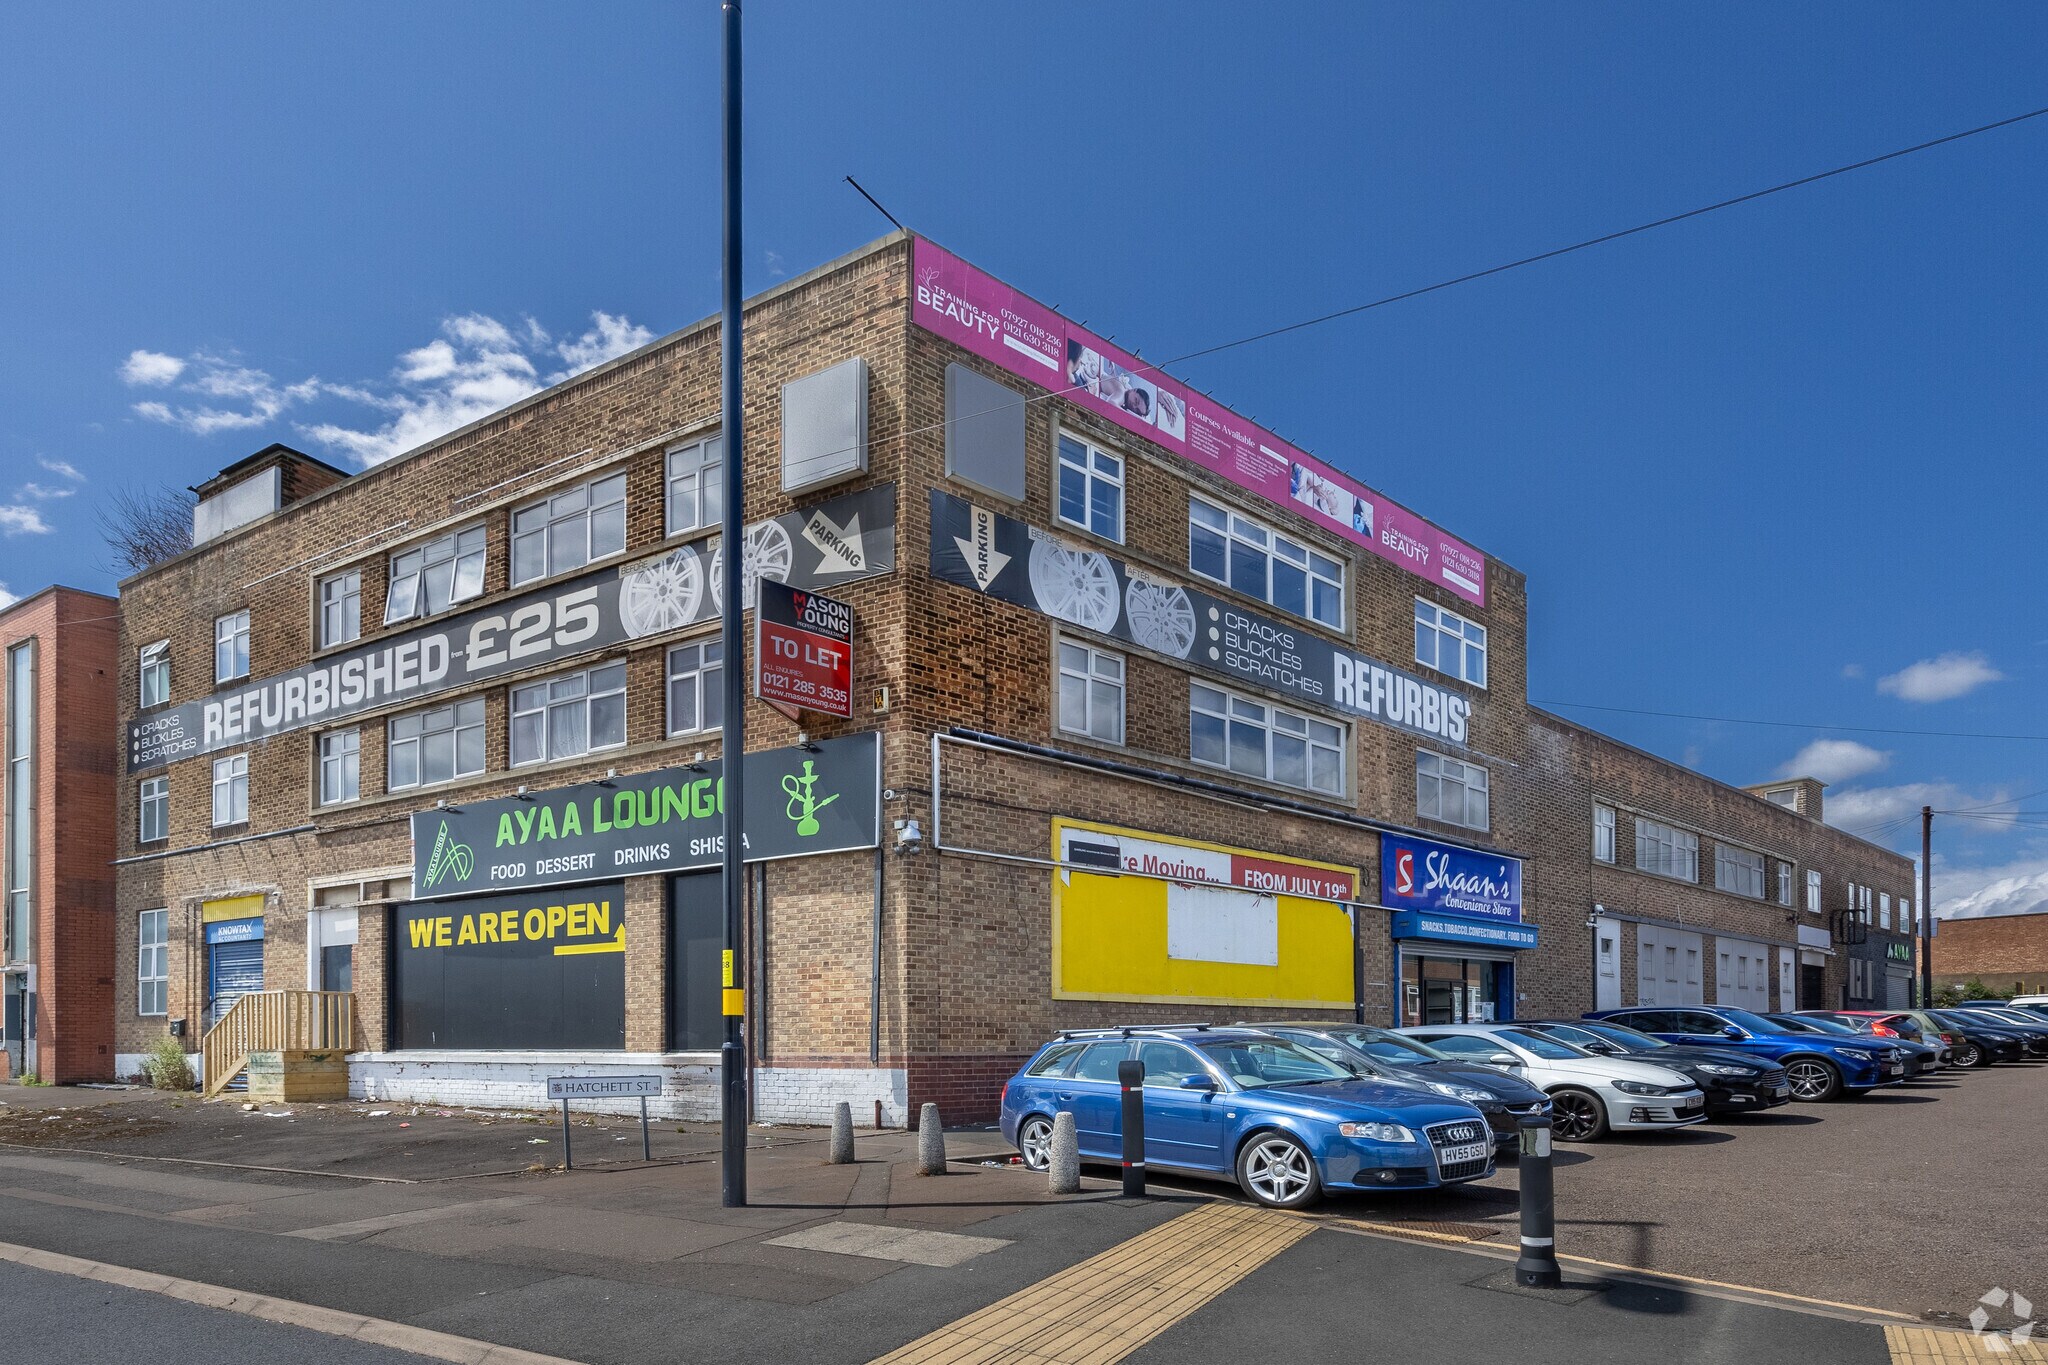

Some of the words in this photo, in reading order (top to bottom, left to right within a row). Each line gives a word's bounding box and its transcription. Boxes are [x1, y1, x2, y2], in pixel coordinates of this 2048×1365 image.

[917, 285, 1000, 340] BEAUTY
[934, 285, 979, 315] TRAINING
[981, 309, 1000, 326] FOR
[1000, 308, 1028, 329] 07927
[1030, 323, 1045, 339] 018
[1046, 332, 1062, 347] 236
[1003, 320, 1022, 337] 0121
[1023, 331, 1040, 347] 630
[1042, 341, 1060, 358] 3118
[1189, 406, 1221, 430] Courses
[1222, 424, 1256, 448] Available
[808, 518, 862, 568] PARKING
[977, 511, 988, 583] PARKING
[1031, 528, 1063, 548] BEFORE
[1382, 530, 1429, 566] BEAUTY
[1391, 528, 1417, 547] TRAINING
[1418, 542, 1430, 553] FOR
[620, 560, 648, 575] BEFORE
[1127, 567, 1150, 582] AFTER
[1441, 555, 1455, 568] 0121
[1455, 562, 1468, 575] 630
[793, 590, 849, 621] MASON
[793, 605, 849, 634] YOUNG
[1225, 612, 1294, 650] CRACKS
[203, 633, 450, 745] REFURBISHED
[450, 649, 464, 660] from
[466, 586, 599, 673] £25
[770, 635, 799, 659] TO
[804, 643, 843, 671] LET
[1225, 631, 1302, 671] BUCKLES
[763, 663, 775, 671] ALL
[1225, 651, 1323, 696] SCRATCHES
[763, 671, 789, 689] 0121
[793, 678, 815, 695] 285
[819, 685, 847, 703] 3535
[763, 686, 847, 712] www.masonyoung.co.uk
[1333, 651, 1472, 744] REFURBIS
[141, 714, 180, 736] CRACKS
[141, 727, 184, 749] BUCKLES
[141, 737, 197, 762] SCRATCHES
[496, 801, 583, 848] AYAA
[490, 862, 527, 881] FOOD
[536, 852, 596, 876] DESSERT
[614, 843, 671, 866] DRINKS
[689, 832, 751, 856] SHISA
[427, 863, 437, 882] AYAA
[1244, 869, 1287, 892] FROM
[1289, 876, 1322, 896] JULY
[1324, 882, 1347, 899] 19th
[1397, 854, 1413, 893] S
[1425, 850, 1510, 900] Shaan's
[1445, 893, 1491, 914] Convenience
[1492, 901, 1512, 917] Store
[217, 920, 254, 936] KNOWTAX
[218, 933, 253, 943] ACCOUNTANTS
[408, 914, 453, 949] WE
[457, 908, 520, 945] ARE
[523, 901, 611, 942] OPEN
[1507, 931, 1520, 942] FOOD
[1520, 933, 1527, 942] TO
[1527, 934, 1534, 943] GO
[1893, 944, 1910, 961] AYAA
[566, 1081, 633, 1094] HATCHETT
[636, 1080, 652, 1092] ST.
[1445, 1147, 1469, 1162] HV55
[1470, 1144, 1484, 1158] GSO
